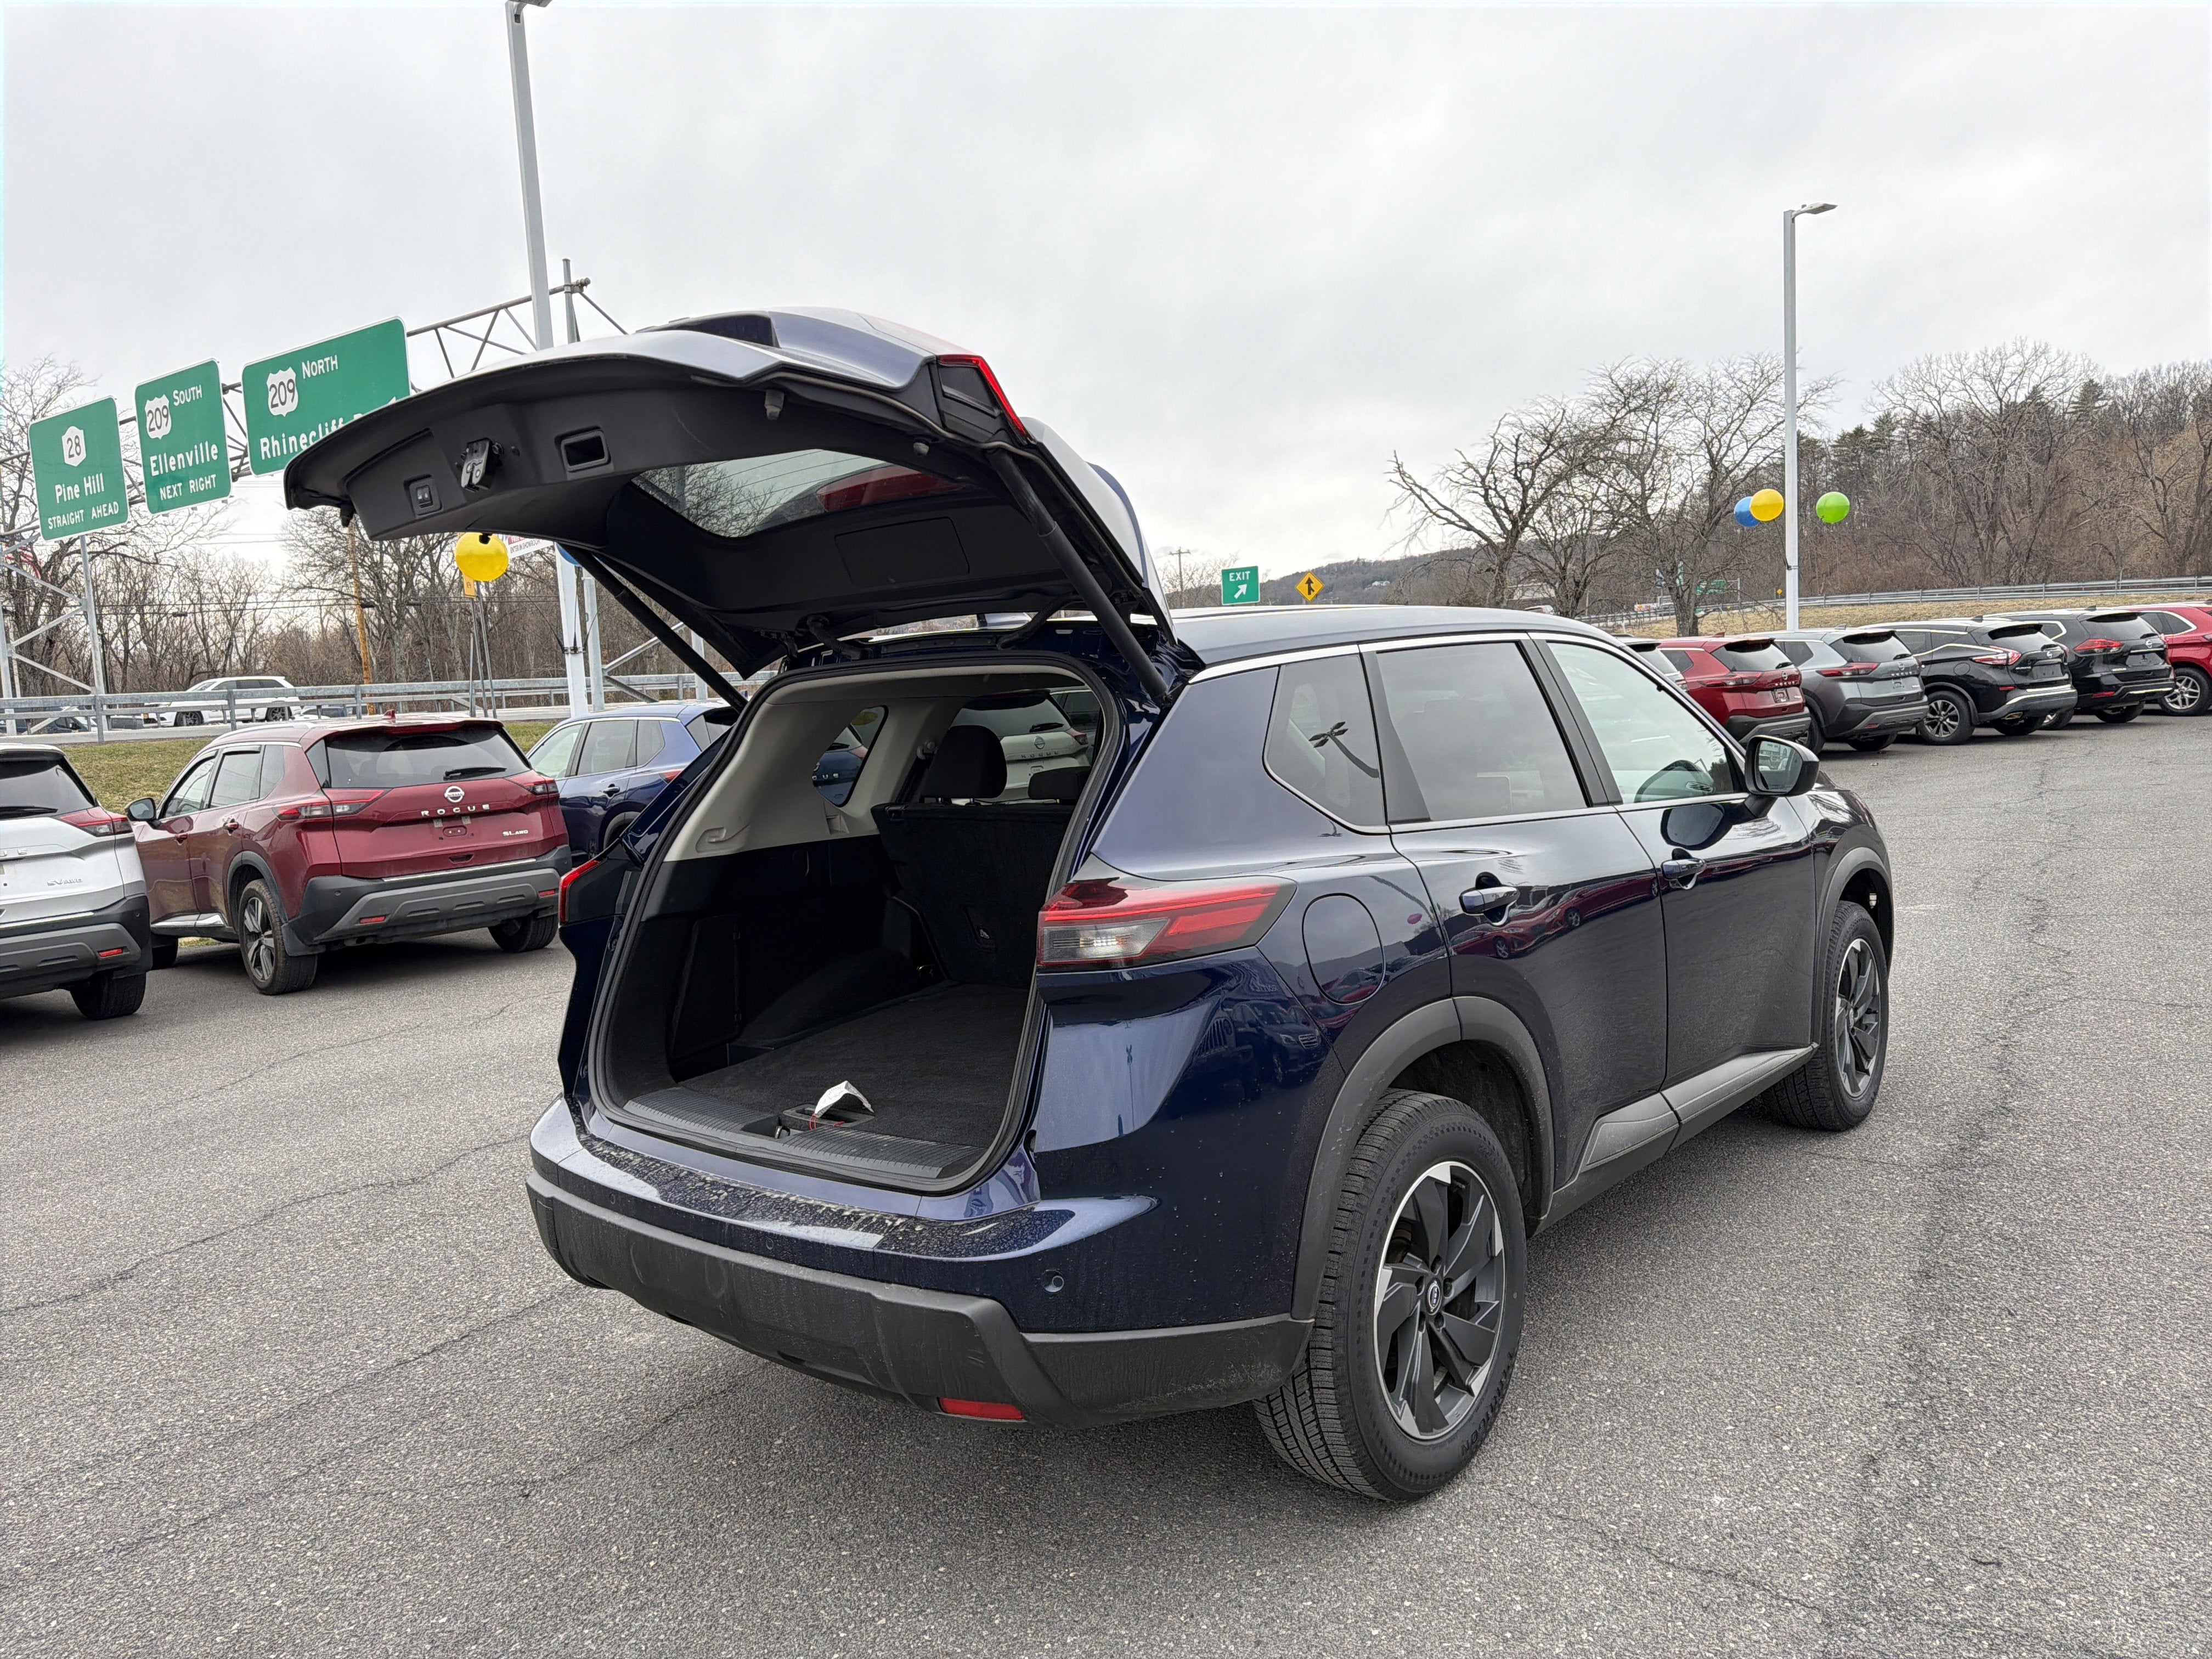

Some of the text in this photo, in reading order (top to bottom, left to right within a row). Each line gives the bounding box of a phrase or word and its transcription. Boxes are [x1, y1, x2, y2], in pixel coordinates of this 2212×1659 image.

[302, 354, 338, 379] NORTH
[173, 385, 202, 406] SOUTH
[269, 379, 295, 409] 209
[147, 405, 169, 432] 209
[66, 435, 82, 459] 28
[150, 441, 218, 477] Ellenville
[55, 472, 104, 504] Pine Hill
[160, 474, 216, 500] NEXT RIGHT
[48, 501, 119, 530] STRAIGHT AHEAD
[1229, 571, 1251, 582] EXIT
[421, 804, 490, 817] ROGUE
